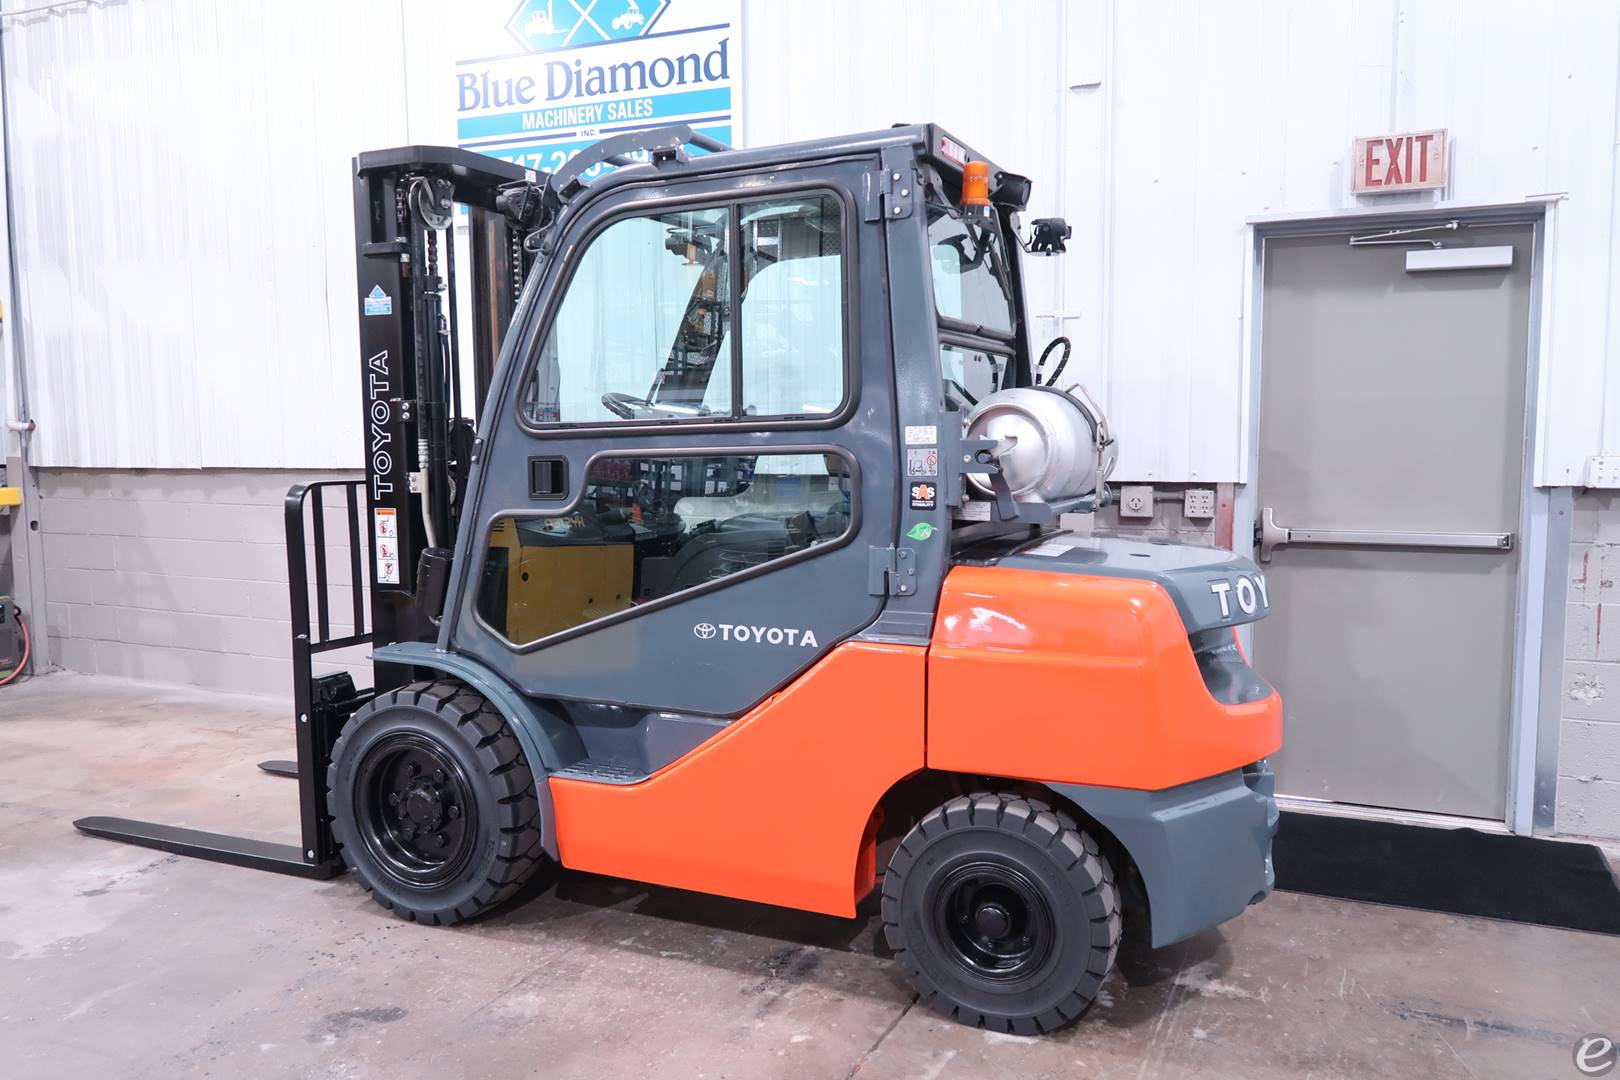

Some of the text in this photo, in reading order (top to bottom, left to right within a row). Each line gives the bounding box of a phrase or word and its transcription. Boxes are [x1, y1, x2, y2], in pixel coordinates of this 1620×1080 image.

[456, 37, 730, 112] Blue Diamond
[522, 99, 653, 131] MACHINERY SALES
[580, 128, 597, 137] INC.
[1365, 135, 1433, 187] EXIT
[369, 350, 393, 500] TOYOTA
[911, 484, 935, 500] SAS
[718, 624, 818, 647] TOYOTA
